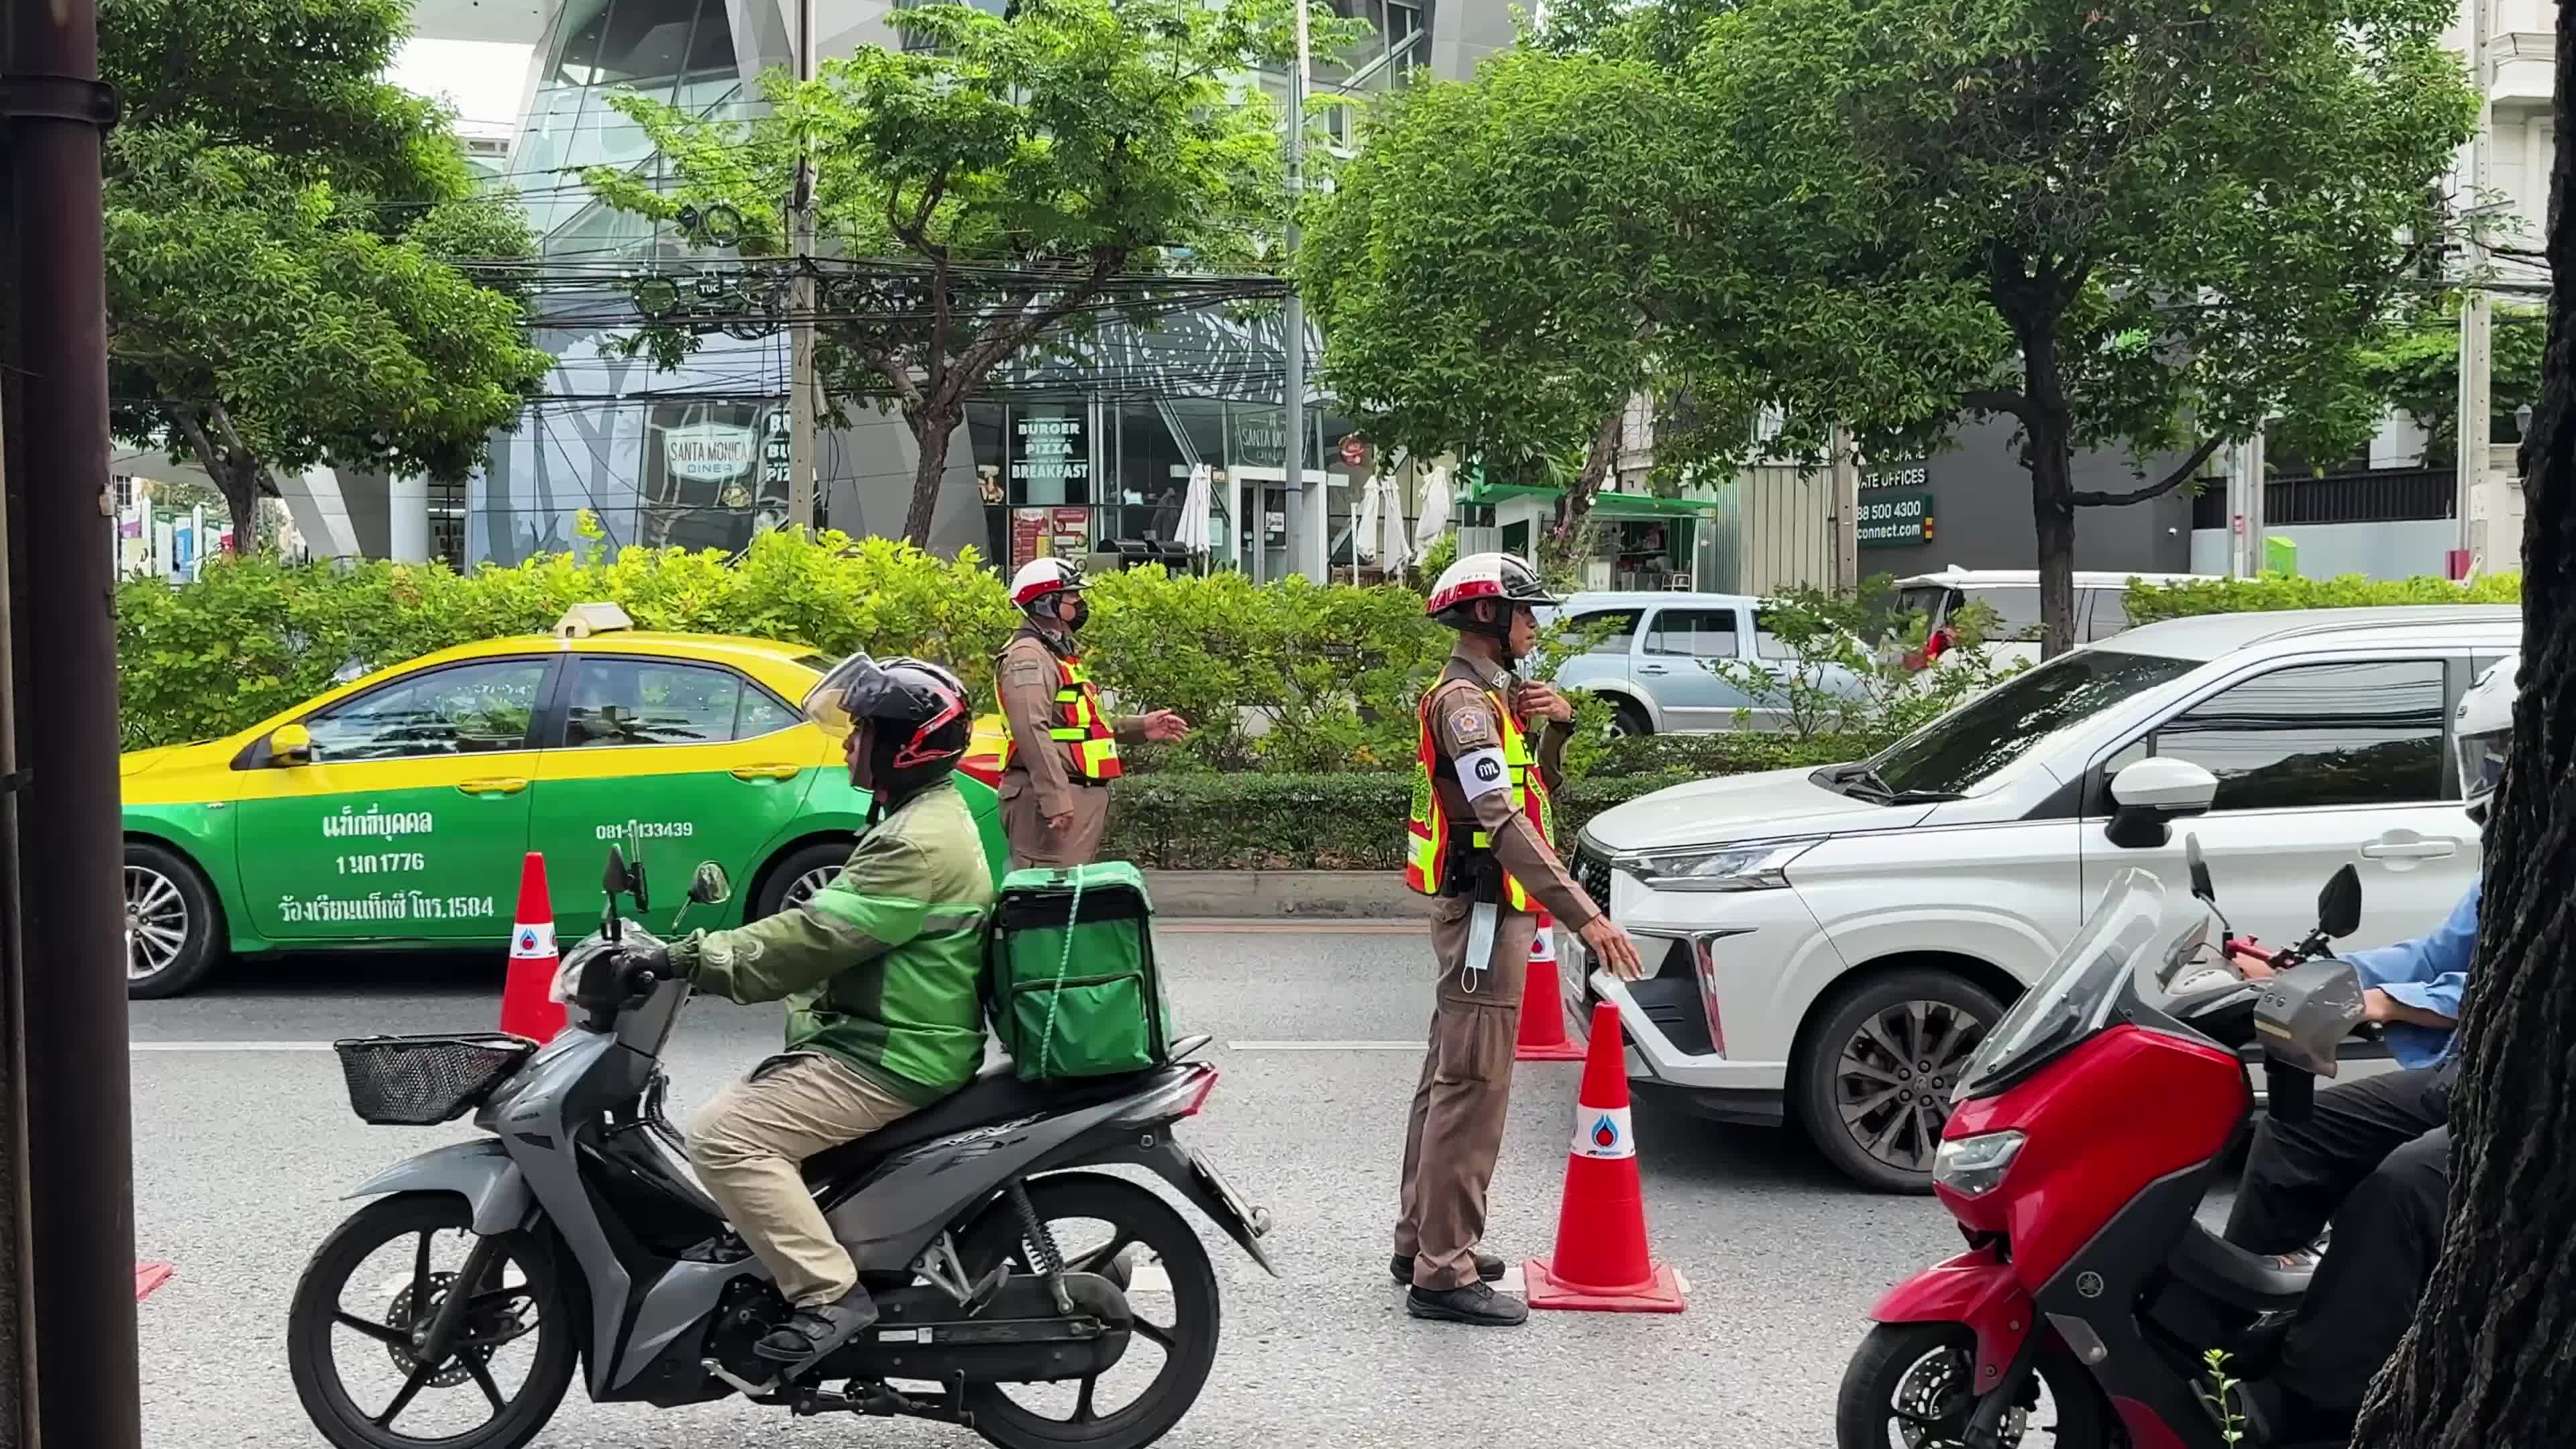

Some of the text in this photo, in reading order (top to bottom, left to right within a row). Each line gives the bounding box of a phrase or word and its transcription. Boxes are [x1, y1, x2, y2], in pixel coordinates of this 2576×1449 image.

[699, 283, 720, 294] TUC
[1018, 423, 1081, 435] BURGER
[670, 441, 705, 462] SANTA
[707, 441, 748, 462] MONICA
[1024, 442, 1073, 455] PIZZA
[687, 464, 733, 474] DINER
[1011, 464, 1089, 479] BREAKFAST
[1881, 468, 1925, 487] OFFICES
[1871, 503, 1891, 520] 500
[1894, 500, 1921, 517] 4300
[323, 802, 433, 842] แท็กซี่บุคคล
[336, 855, 345, 875] 1
[380, 852, 425, 873] 1776
[408, 889, 495, 920] โทร.1584
